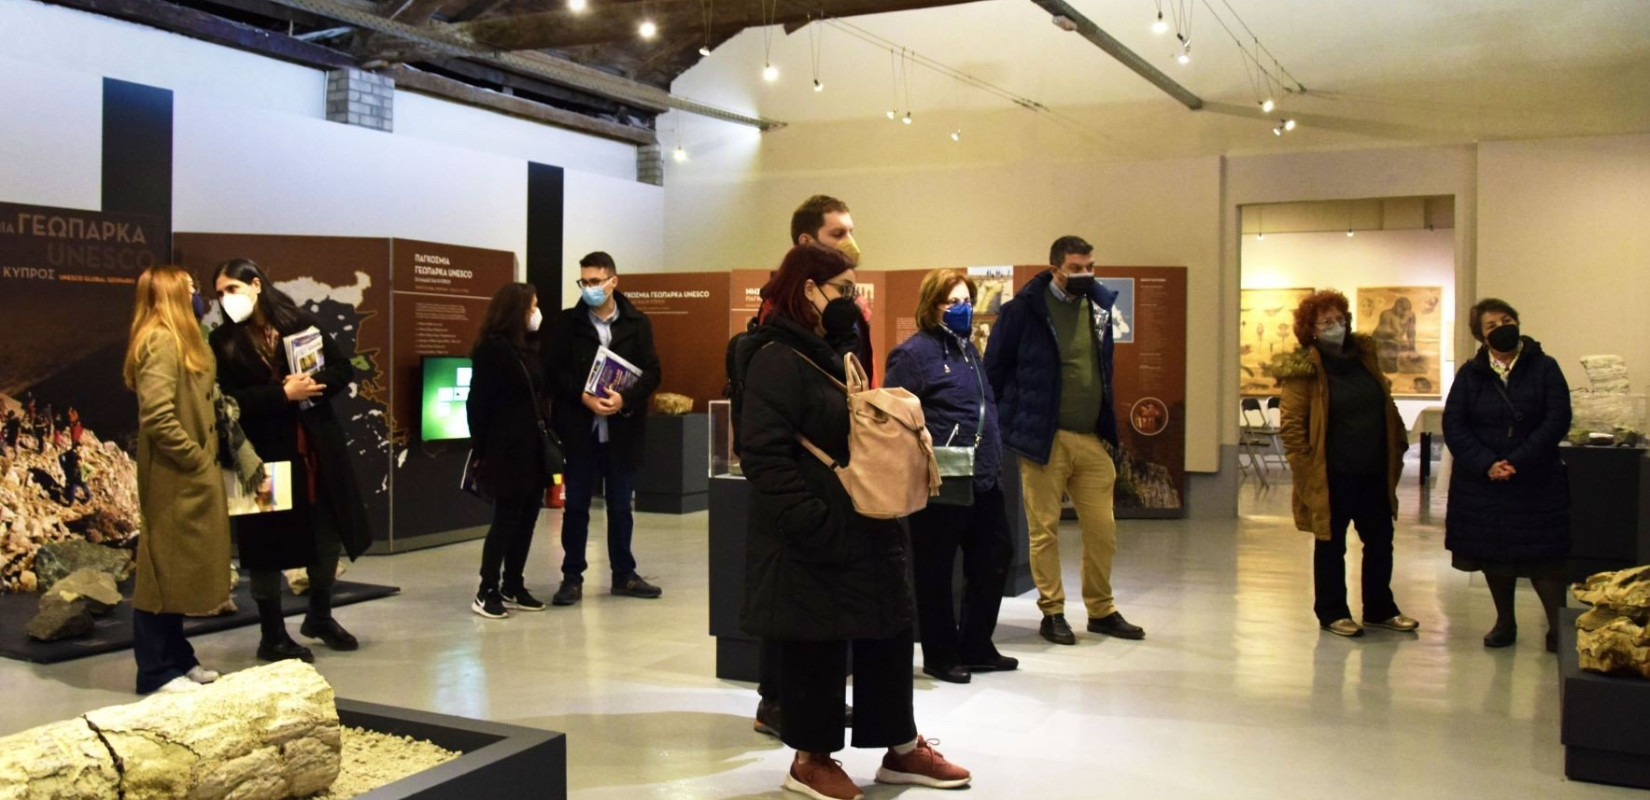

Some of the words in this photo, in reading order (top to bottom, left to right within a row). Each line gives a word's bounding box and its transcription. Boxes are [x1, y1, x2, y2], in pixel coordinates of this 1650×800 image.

[18, 213, 146, 244] ΓΕΩΠΑΡΚΑ
[47, 242, 155, 270] UNESCO
[415, 254, 450, 265] ΠΑΓΚΟΣΜΙΑ
[3, 266, 55, 280] ΚΥΠΡΟΣ
[448, 269, 472, 279] UNESCO
[684, 290, 710, 298] UNESCO
